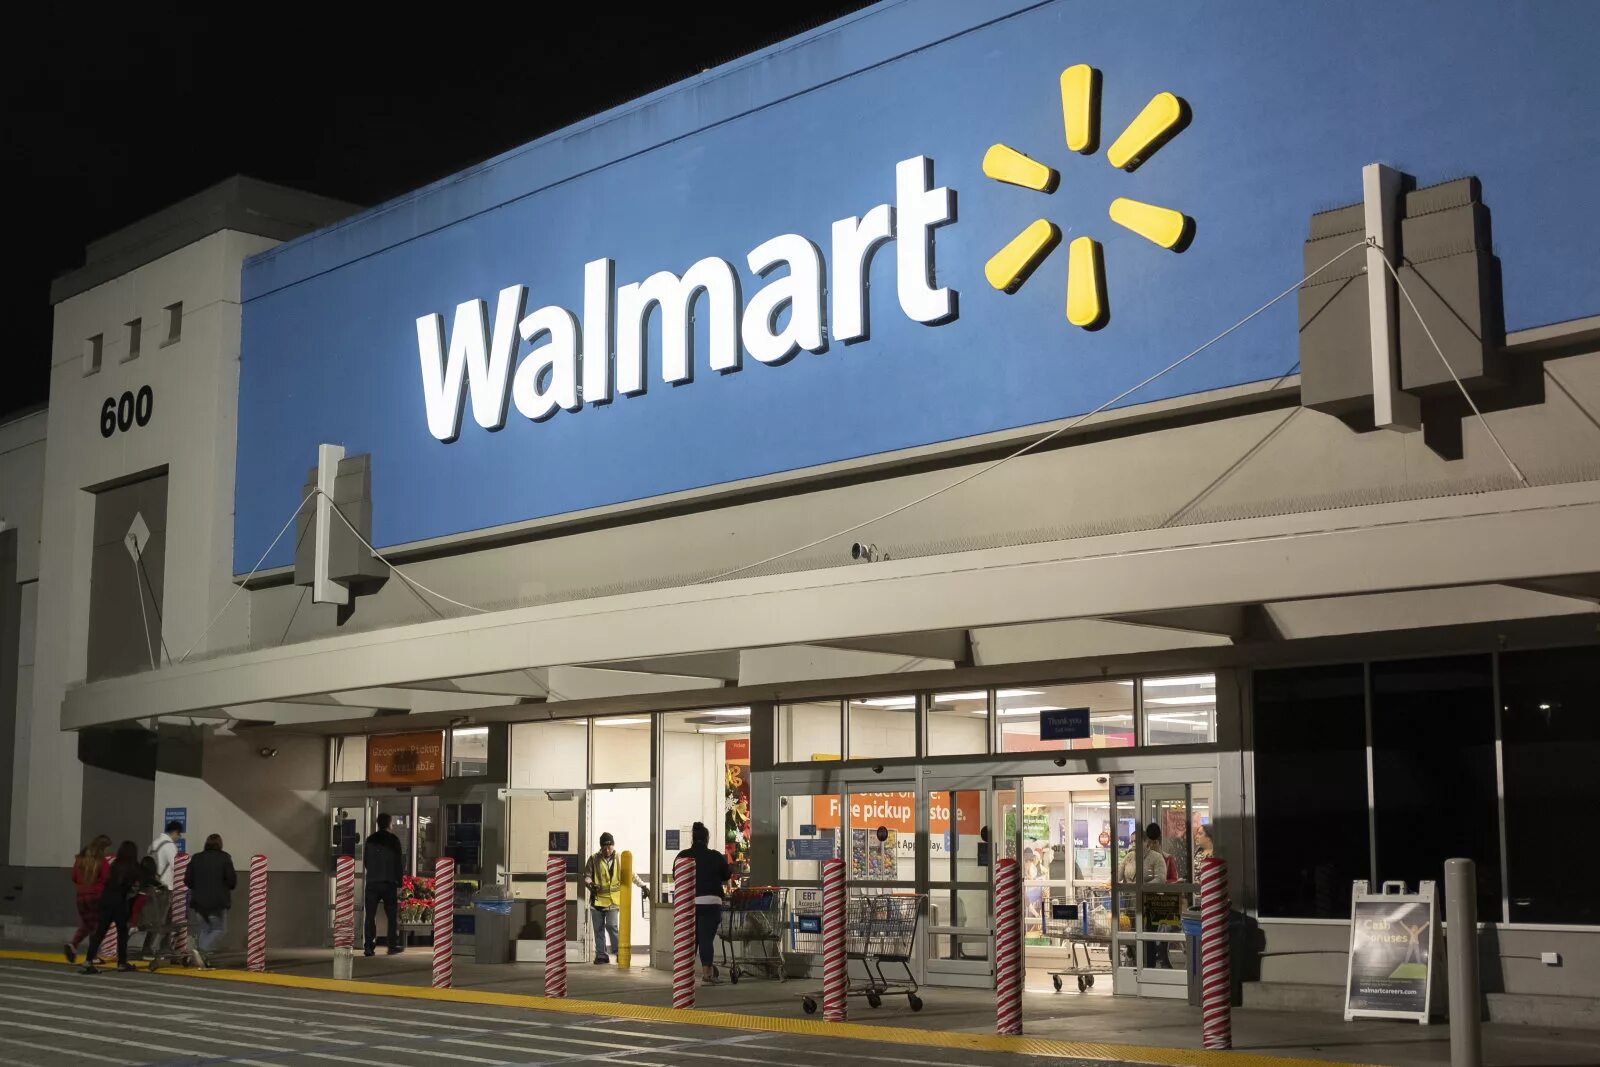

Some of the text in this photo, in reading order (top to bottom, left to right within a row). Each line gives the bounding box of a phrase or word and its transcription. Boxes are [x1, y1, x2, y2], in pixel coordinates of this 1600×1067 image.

[415, 154, 958, 443] Walmart
[100, 384, 153, 438] 600
[1048, 717, 1082, 727] Thank you
[409, 744, 440, 756] Pickup
[864, 801, 911, 822] pickup
[929, 804, 966, 821] stoe.
[803, 892, 816, 900] EBT
[1360, 987, 1417, 995] walmartcareers.com
